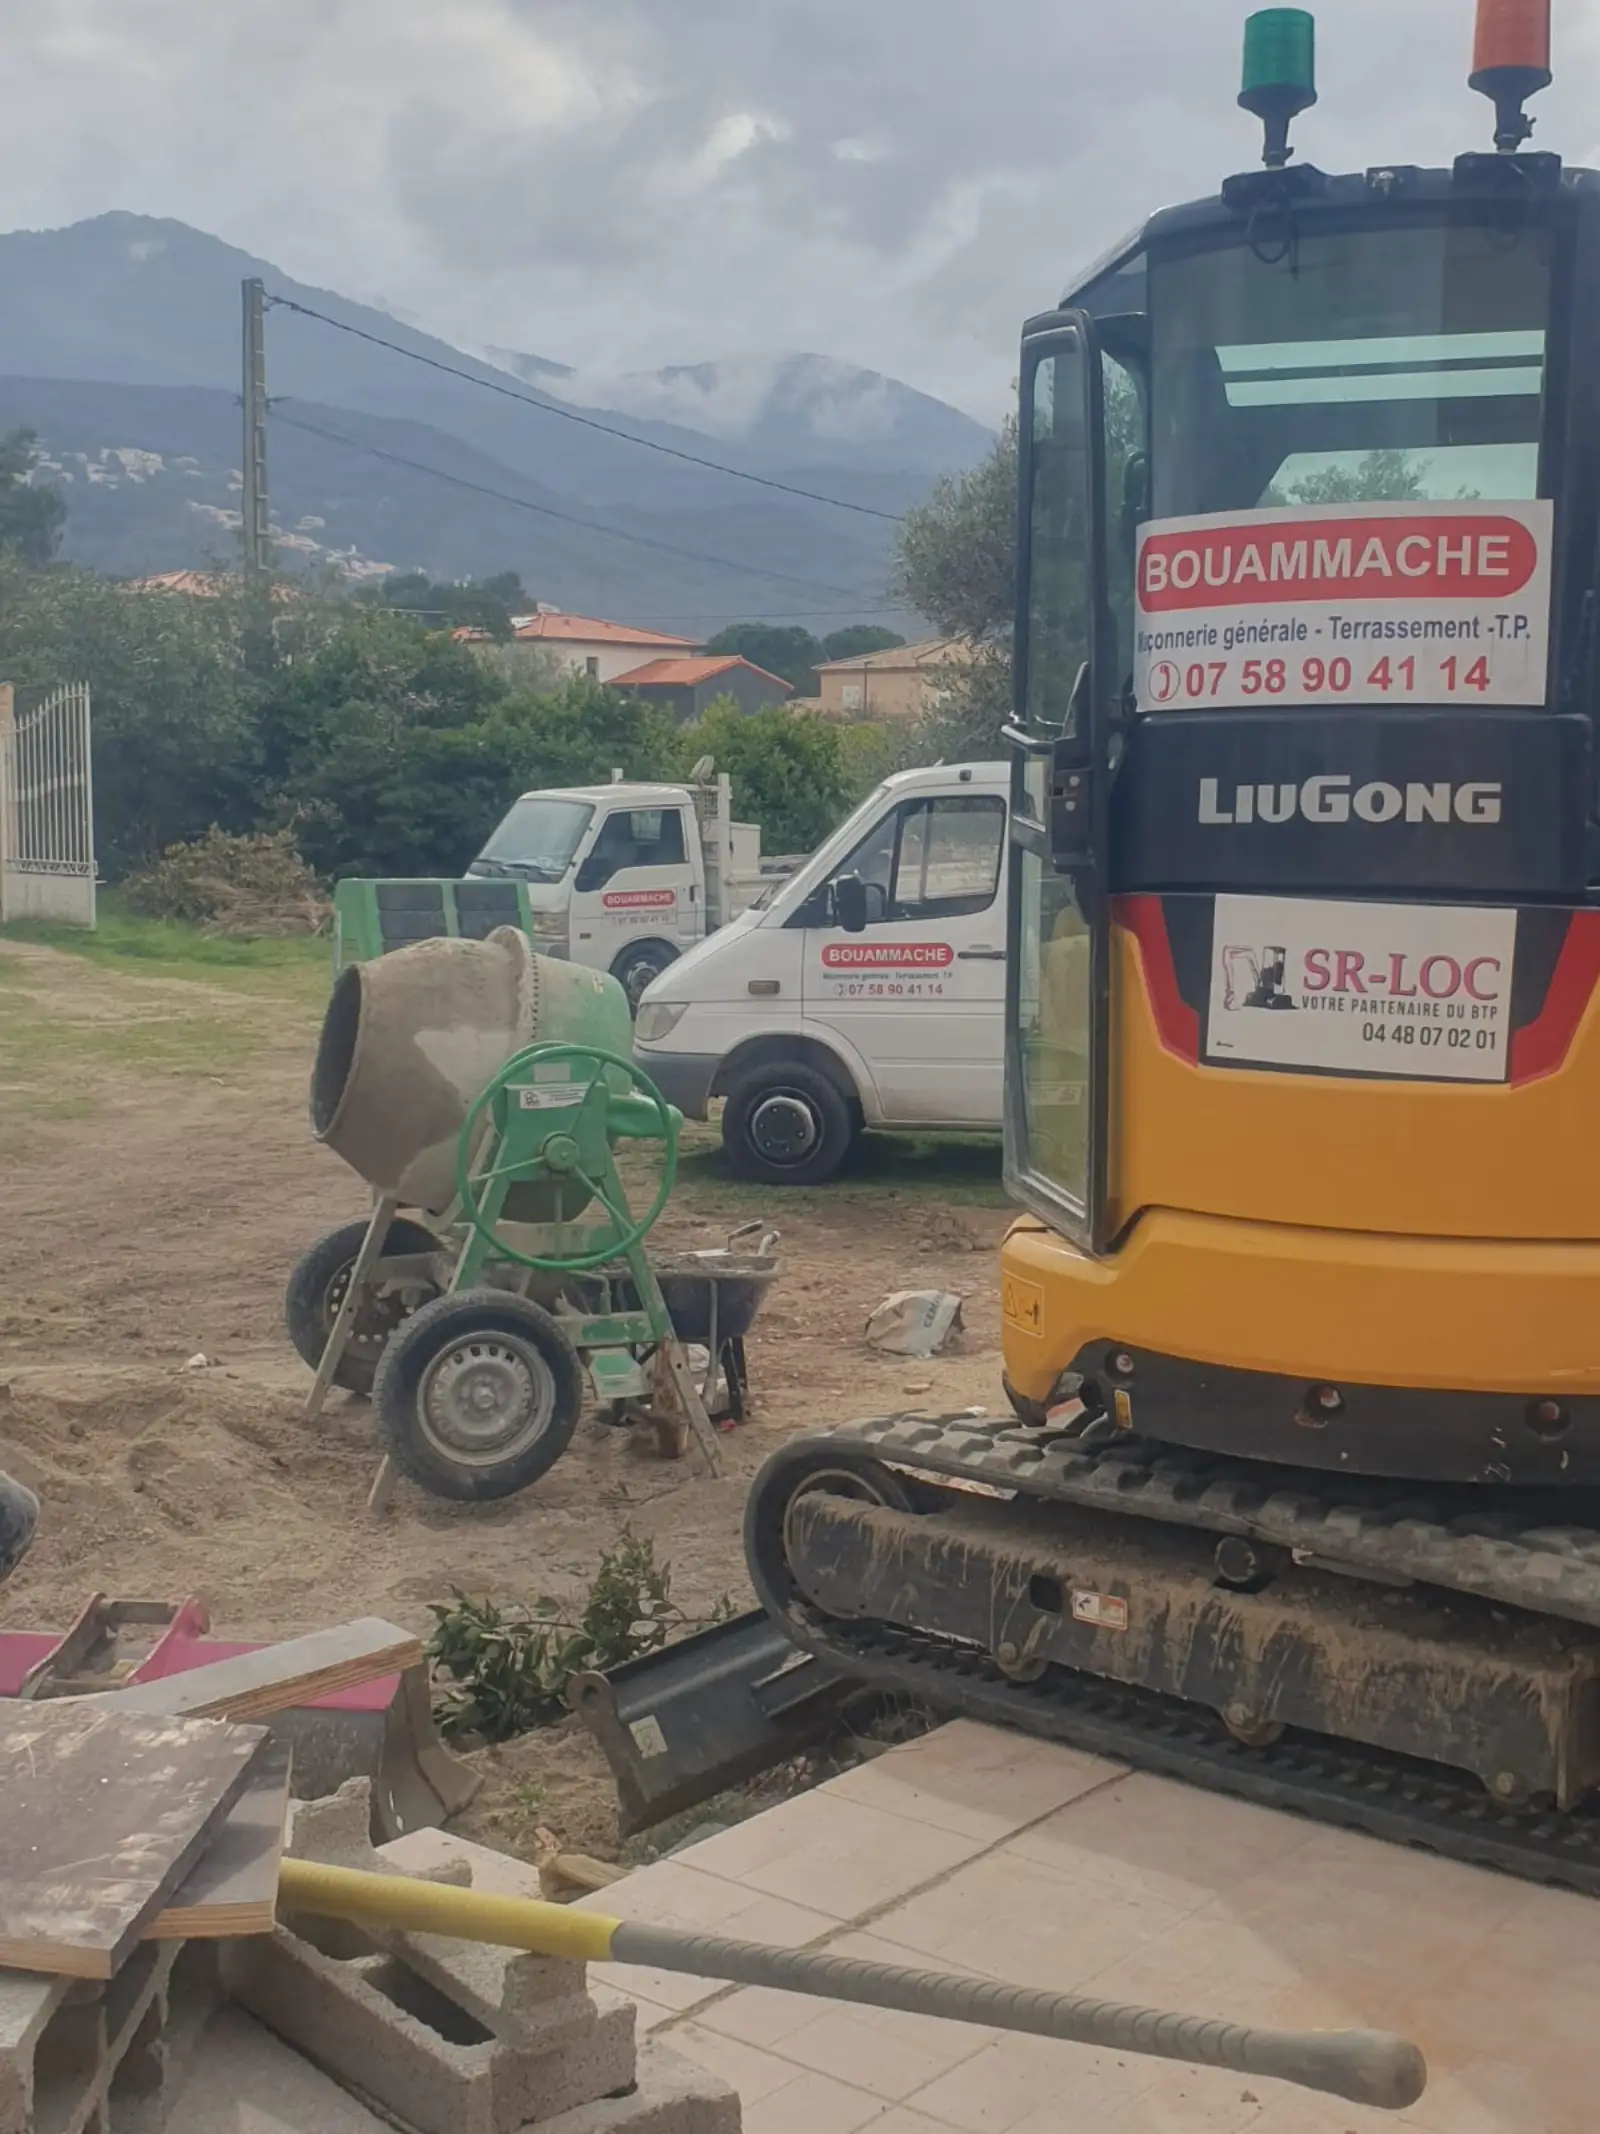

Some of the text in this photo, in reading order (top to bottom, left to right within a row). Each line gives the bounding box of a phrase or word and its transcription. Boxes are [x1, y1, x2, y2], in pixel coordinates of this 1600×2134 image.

[1145, 534, 1511, 593] BOUAMMACHE
[1223, 617, 1308, 650] générale
[1328, 616, 1480, 640] Terrassement
[1186, 655, 1491, 697] 07 58 90 41 14
[829, 948, 947, 962] BOUAMMACHE
[848, 983, 864, 995] 07
[888, 983, 903, 995] 90
[907, 983, 922, 995] 41
[1303, 948, 1501, 1001] SR-LOC
[1302, 995, 1498, 1020] VOTRE PARTENAIRE DU BTP
[1363, 1022, 1496, 1050] 04 48 07 02 01
